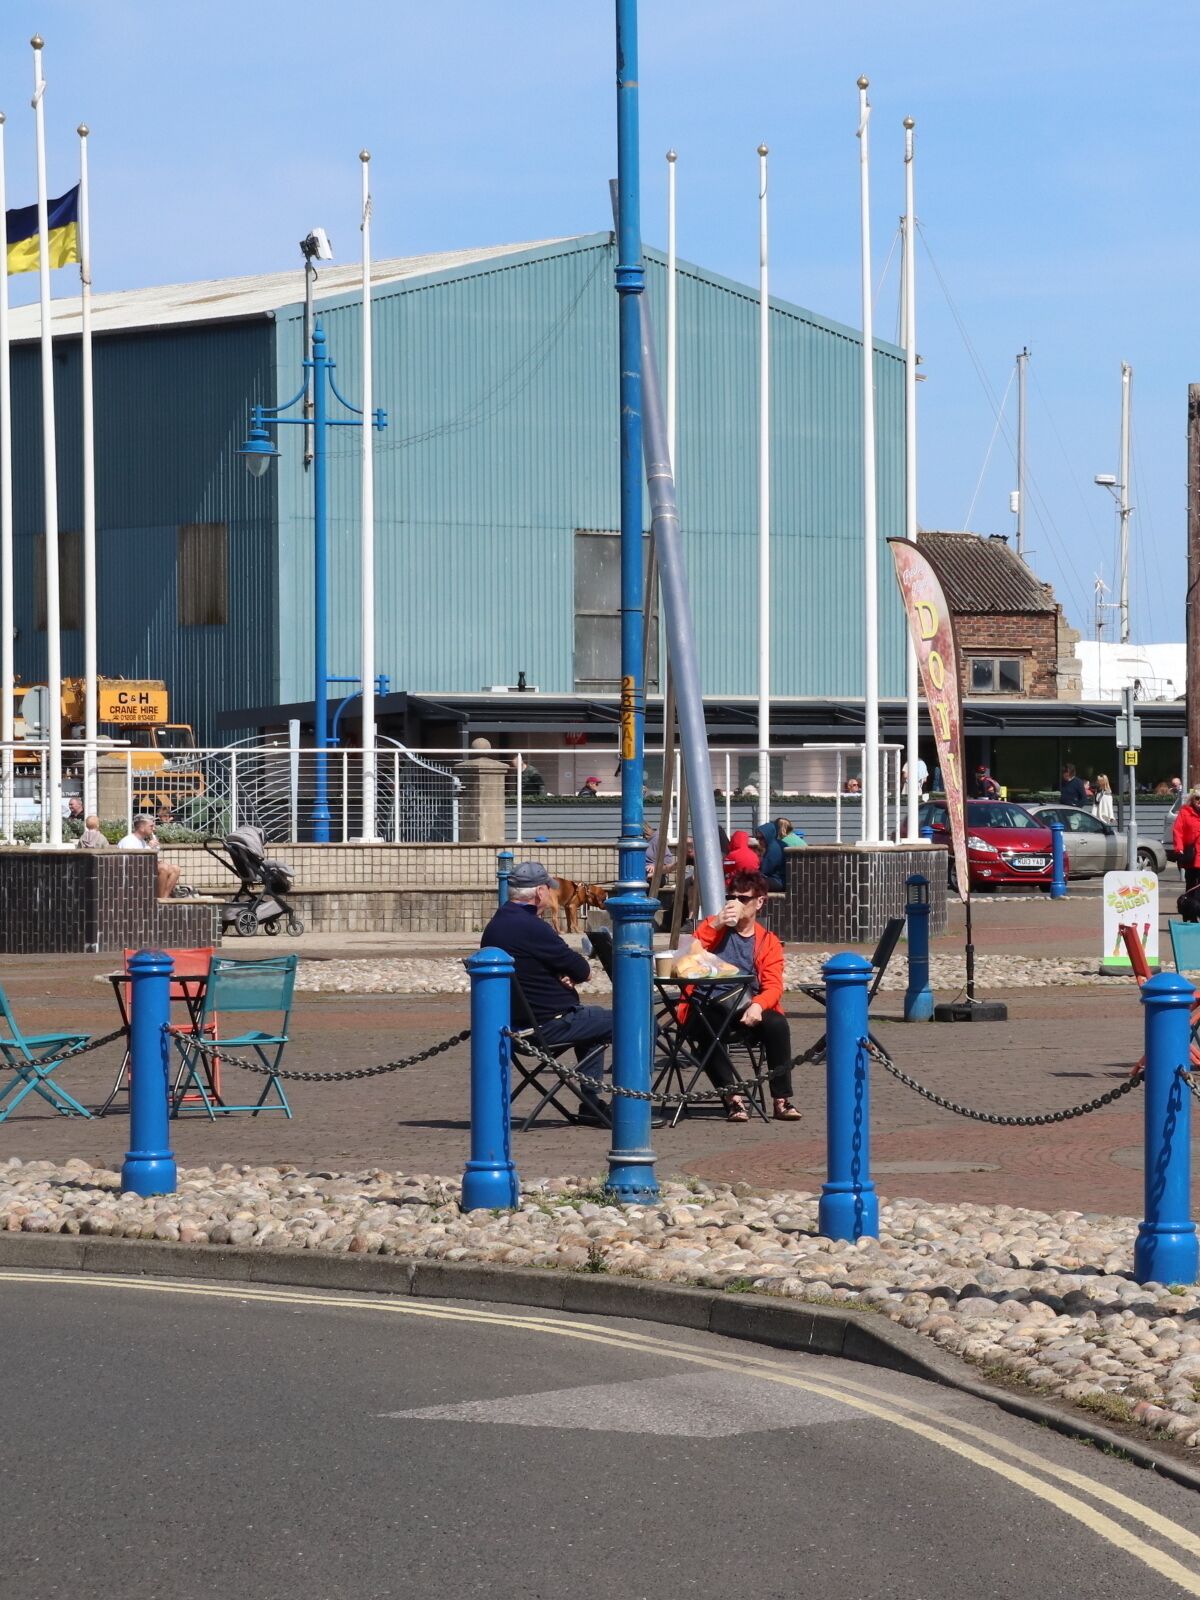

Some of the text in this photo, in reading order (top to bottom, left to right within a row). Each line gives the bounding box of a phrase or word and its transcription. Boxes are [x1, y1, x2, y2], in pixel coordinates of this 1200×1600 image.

[118, 692, 128, 704] C
[139, 692, 149, 704] H
[110, 706, 159, 714] CRANE HIRE
